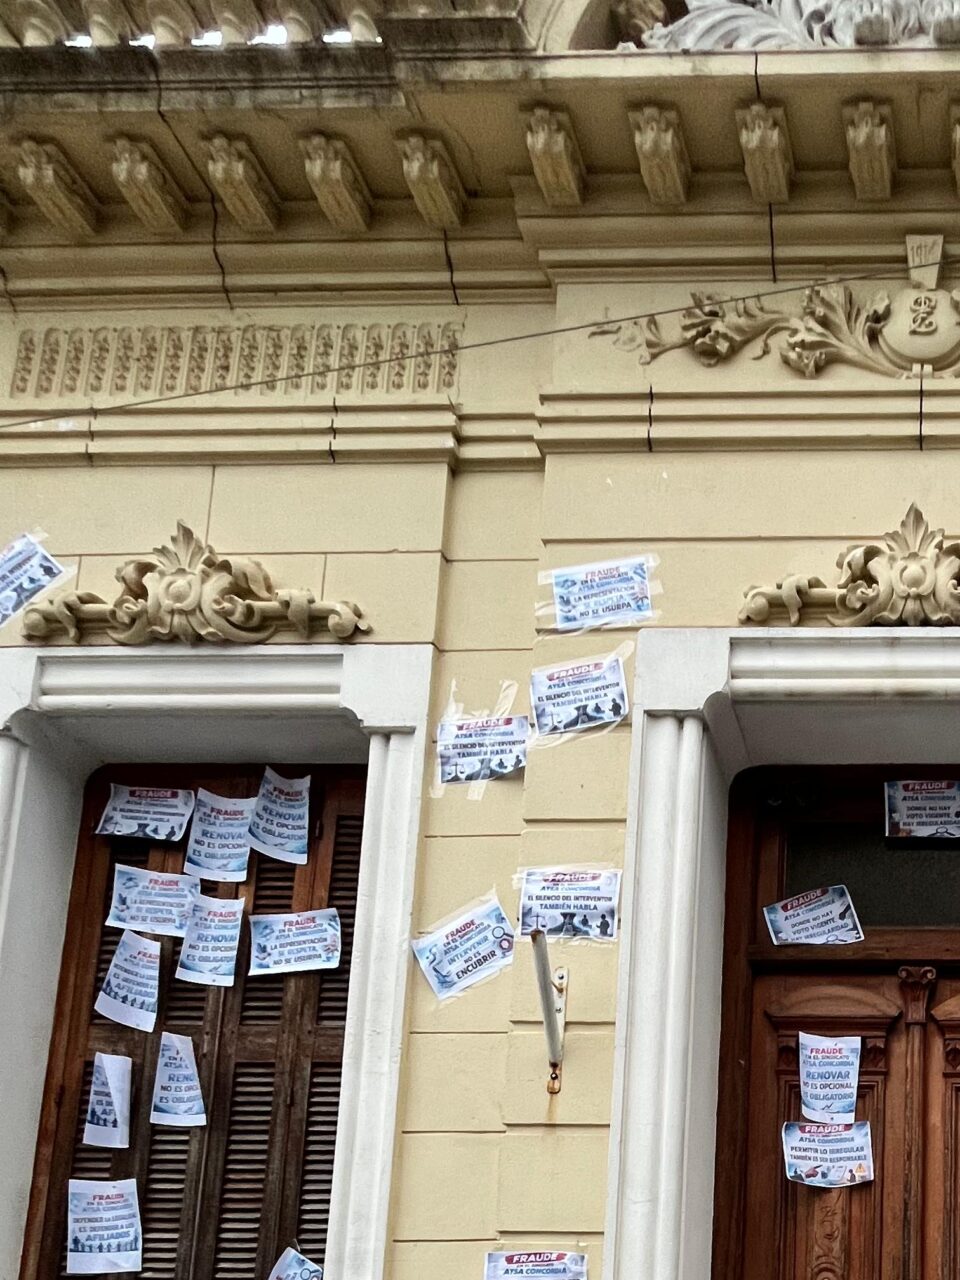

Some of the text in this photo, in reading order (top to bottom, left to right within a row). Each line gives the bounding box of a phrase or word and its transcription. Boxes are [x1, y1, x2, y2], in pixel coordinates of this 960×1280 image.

[585, 567, 620, 578] FRAUDE
[554, 665, 595, 679] FRAUDE
[908, 782, 947, 791] FRAUDE
[787, 890, 822, 910] FRAUDE
[540, 903, 572, 911] TAMBIÉN
[283, 917, 317, 927] FRAUDE
[445, 919, 477, 940] FRAUDE
[447, 935, 489, 965] INTERVENIR
[456, 950, 498, 980] ENCUBRIR
[810, 1047, 843, 1055] FRAUDE
[806, 1070, 850, 1080] RENOVAR
[512, 1254, 558, 1262] FRAUDE
